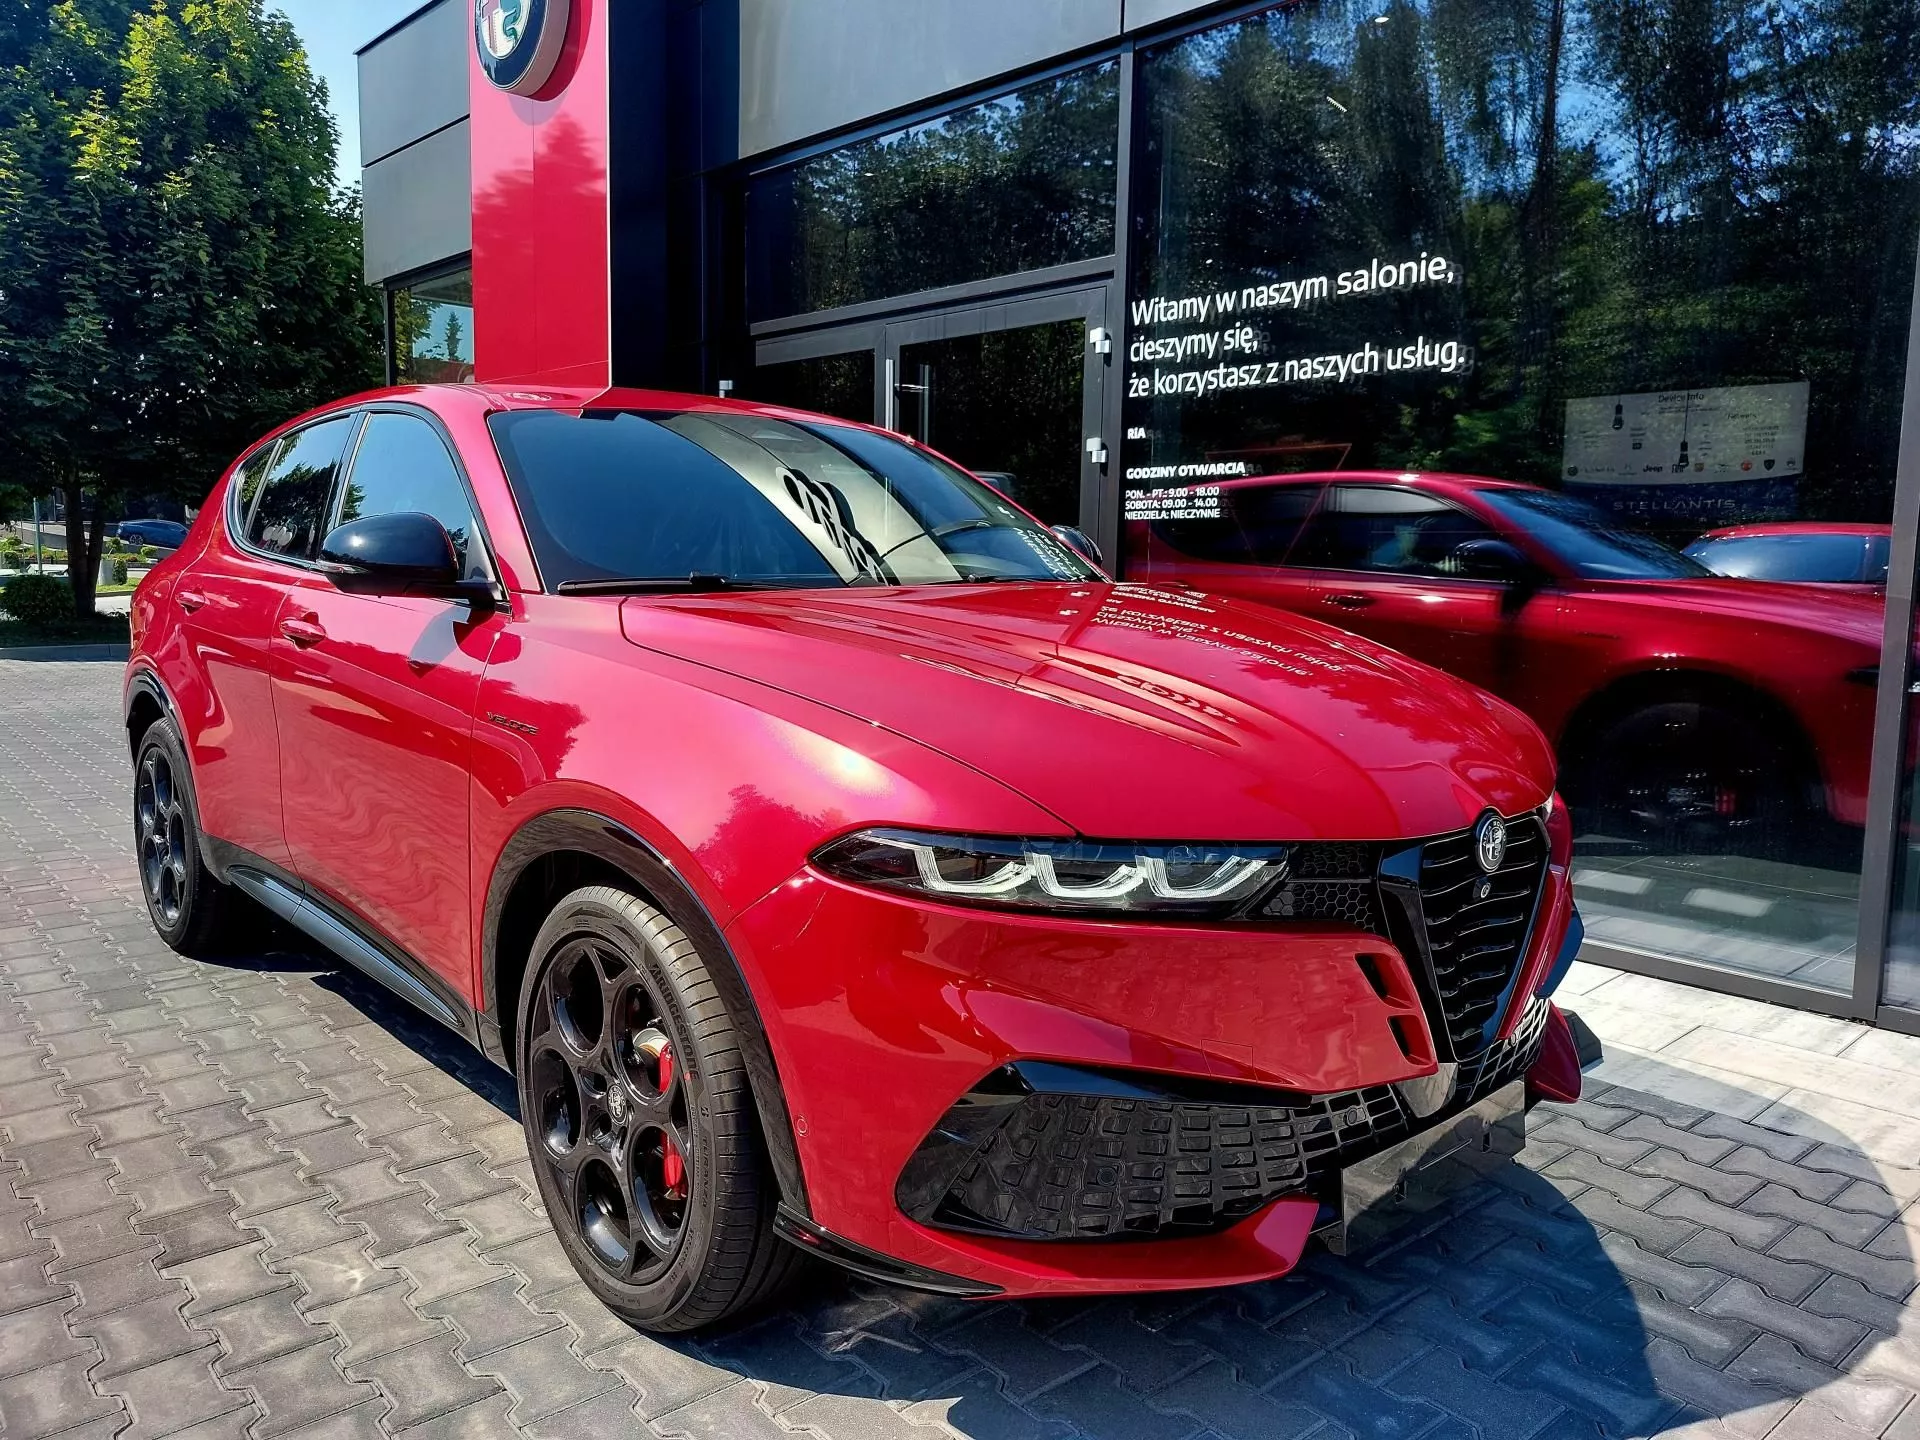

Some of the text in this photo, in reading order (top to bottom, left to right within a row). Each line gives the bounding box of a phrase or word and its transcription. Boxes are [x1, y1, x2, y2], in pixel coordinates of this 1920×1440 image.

[1132, 251, 1454, 326] Witamy w naszym salonie,
[1130, 322, 1258, 363] cieszymy się,
[1129, 336, 1465, 398] że korzystasz z naszych usług.
[1126, 462, 1245, 479] GODZINY OTWARCIA
[1643, 465, 1663, 473] Jeep
[1125, 489, 1145, 499] PON.
[1168, 488, 1188, 498] 9.00
[1196, 486, 1220, 496] 18.00
[1125, 500, 1161, 510] SOBOTA:
[1162, 498, 1187, 509] 09.00
[1194, 497, 1218, 507] 14.00
[1613, 499, 1736, 510] STELLANTIS
[1124, 508, 1220, 520] NIEDZIELA: NIECZYNNE
[486, 711, 539, 735] VELOCE
